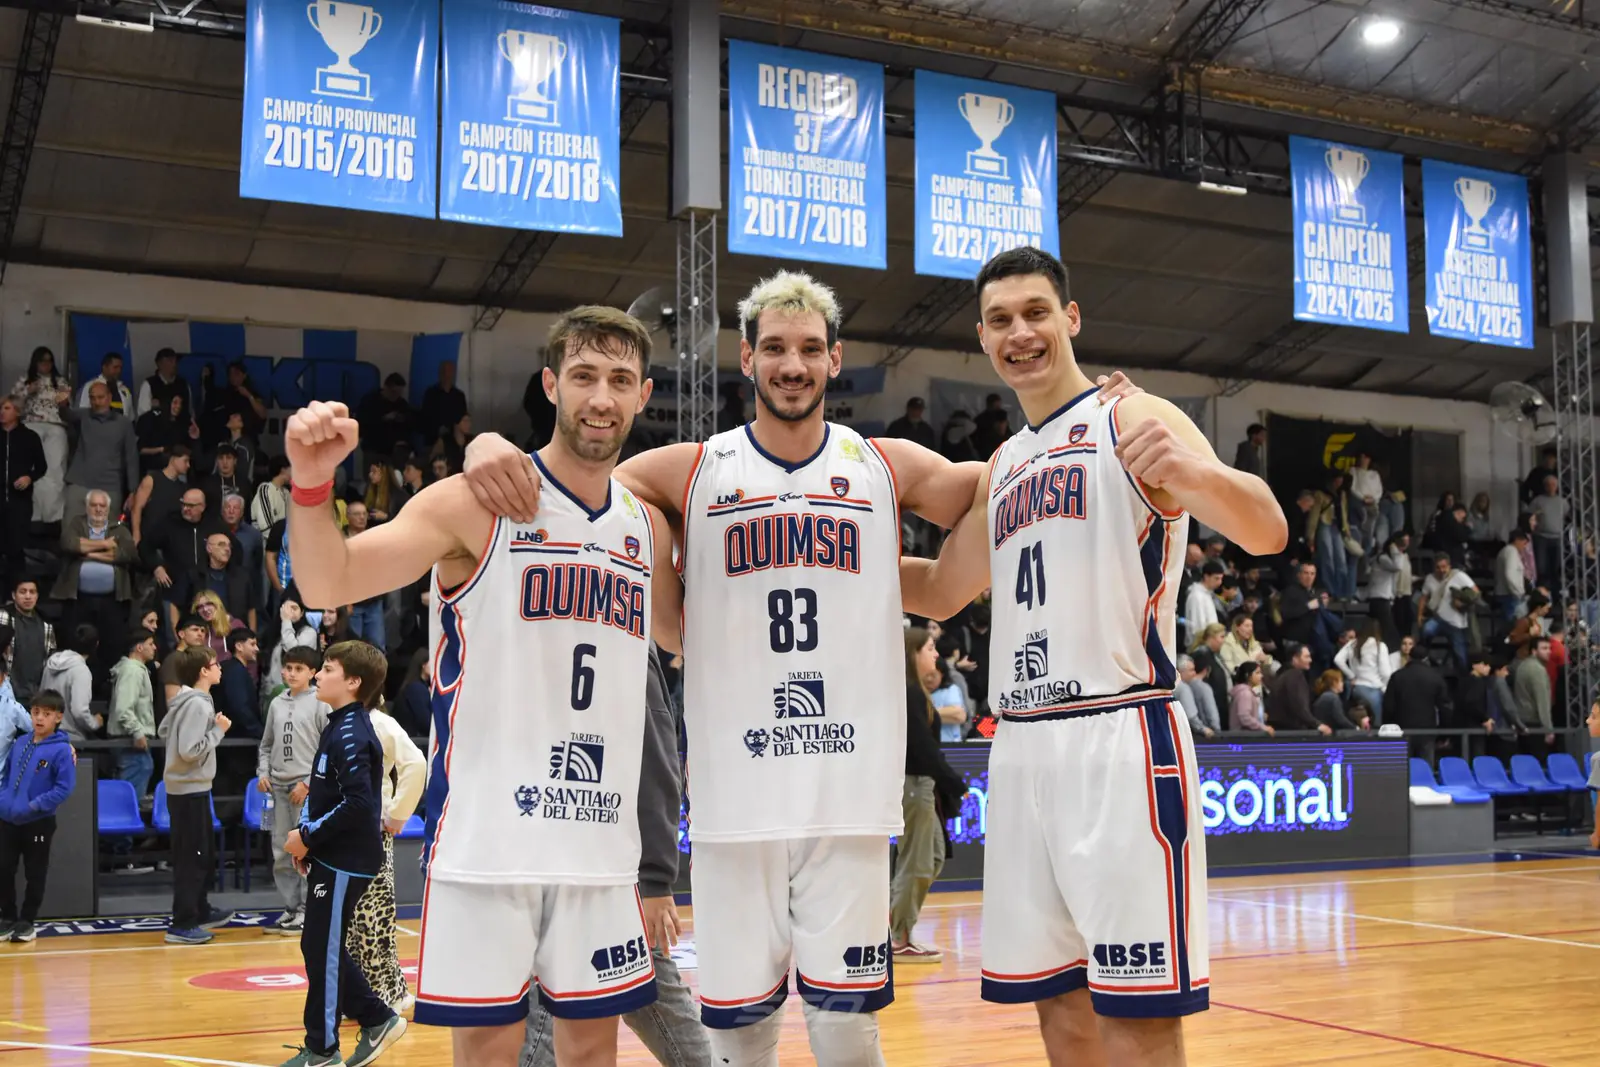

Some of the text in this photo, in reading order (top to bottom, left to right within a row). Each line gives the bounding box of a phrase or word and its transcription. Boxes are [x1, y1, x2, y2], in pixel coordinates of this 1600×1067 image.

[758, 63, 858, 119] RECORD
[263, 97, 417, 139] CAMPEÓN PROVINCIAL
[794, 112, 824, 153] 37
[264, 124, 415, 182] 2015/2016
[459, 121, 601, 161] CAMPEÓN FEDERAL
[462, 151, 601, 203] 2017/2018
[743, 166, 865, 206] TORNEO FEDERAL
[797, 155, 866, 180] CONSECUTIVAS
[931, 173, 984, 201] CAMPEÓN
[987, 182, 1019, 205] CONF.
[743, 196, 867, 249] 2017/2018
[931, 194, 1043, 234] LIGA ARGENTINA
[1303, 221, 1391, 268] CAMPEÓN
[1304, 258, 1394, 293] LIGA ARGENTINA
[1499, 256, 1508, 282] A
[1306, 283, 1394, 322] 2024/2025
[1463, 277, 1520, 307] NACIONAL
[1437, 297, 1522, 339] 2024/2025
[717, 493, 739, 504] LNB
[995, 464, 1087, 551] QUIMSA
[516, 531, 543, 543] LNB
[725, 513, 860, 577] QUIMSA
[1015, 540, 1046, 611] 41
[520, 563, 645, 641] QUIMSA
[767, 588, 819, 653] 83
[571, 643, 597, 711] 6
[788, 671, 823, 680] TARJETA
[1014, 645, 1025, 683] SOL
[773, 682, 787, 719] SOL
[1011, 680, 1082, 705] SANTIAGO
[283, 721, 294, 763] 1993
[571, 732, 604, 744] TARJETA
[773, 723, 855, 743] SANTIAGO
[774, 740, 855, 757] DEL ESTERO
[549, 741, 566, 780] SOL
[543, 786, 622, 810] SANTIAGO
[1199, 763, 1347, 827] sonal
[543, 805, 618, 824] DEL ESTERO
[610, 934, 647, 968] BSE
[862, 943, 888, 967] BS
[1108, 941, 1166, 967] BSE
[597, 969, 623, 979] BANCO
[1123, 967, 1166, 975] SANTIAGO
